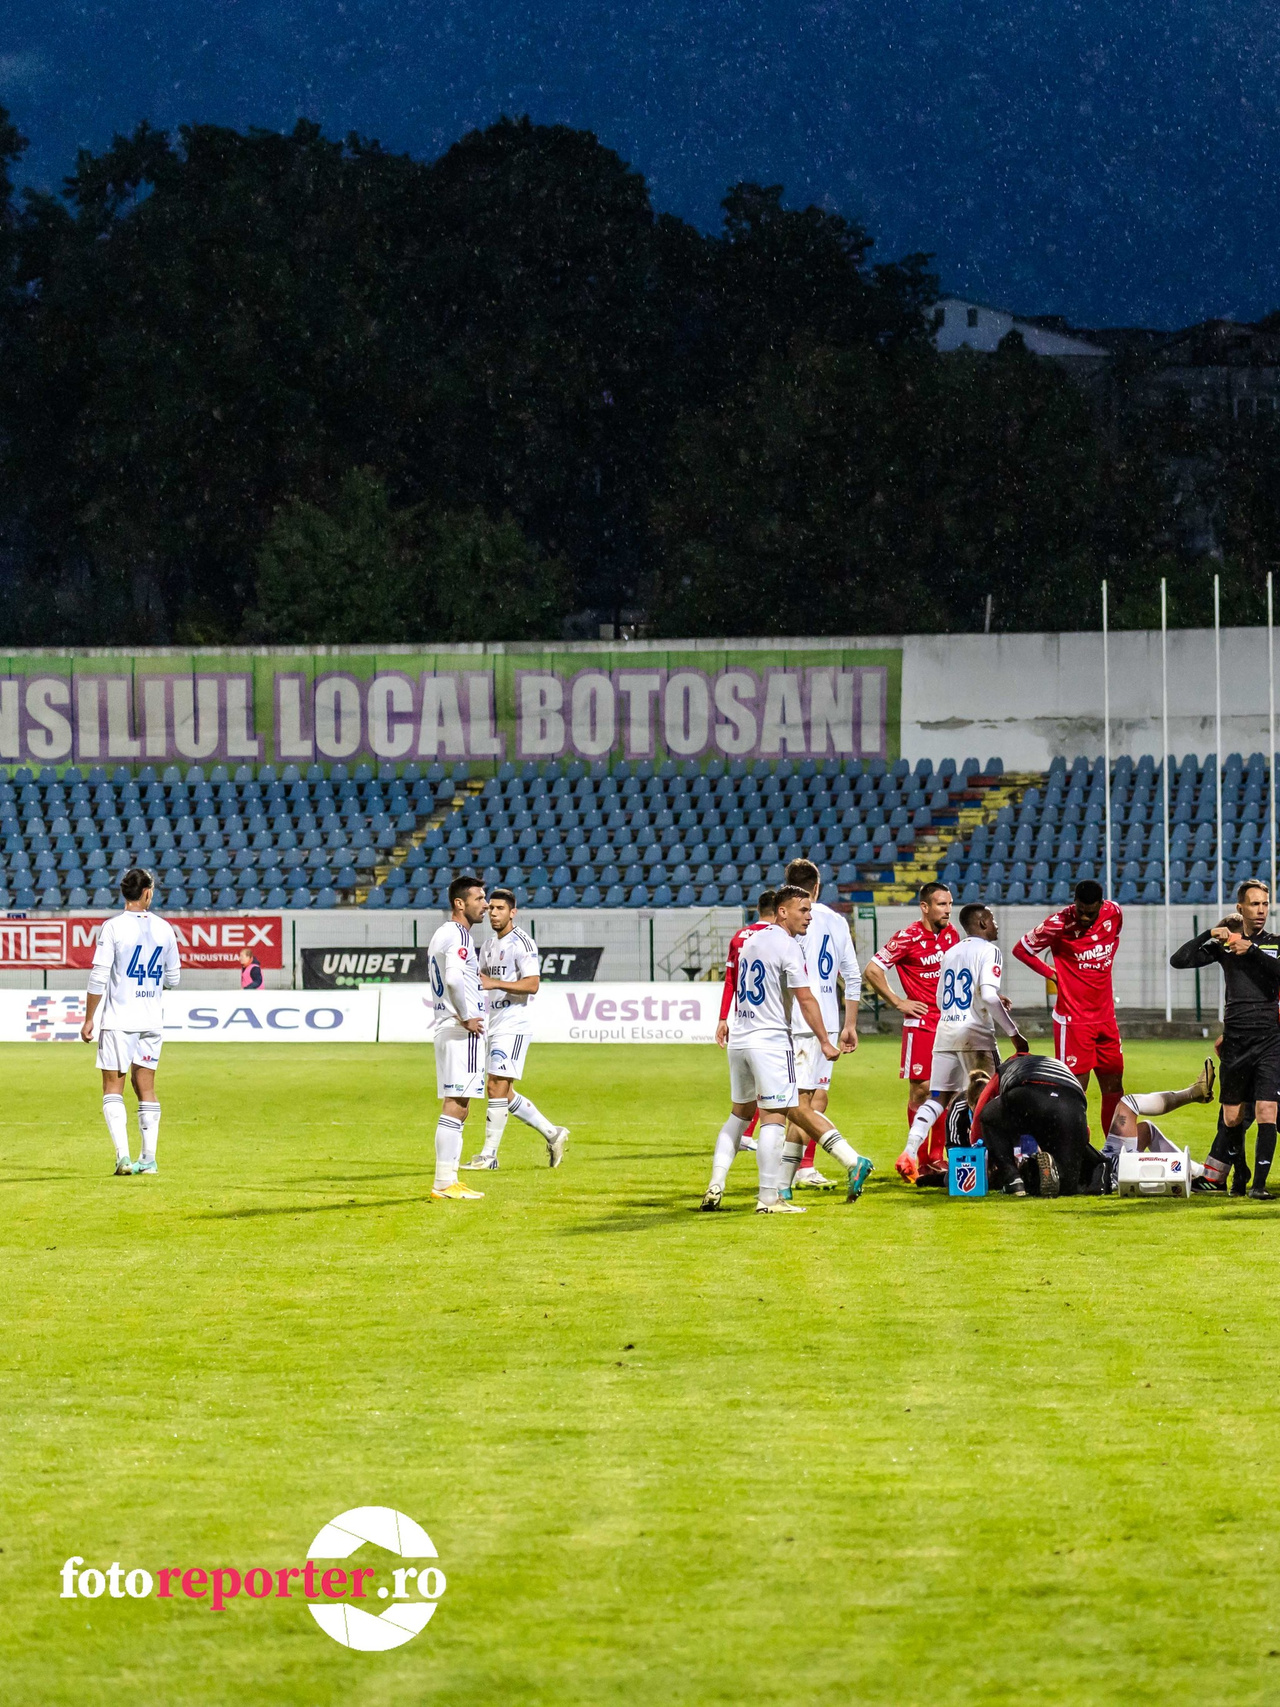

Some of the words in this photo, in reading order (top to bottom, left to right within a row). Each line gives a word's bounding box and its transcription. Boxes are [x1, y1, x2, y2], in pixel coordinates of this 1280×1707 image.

[280, 676, 500, 758] LOCAL
[521, 671, 881, 755] BOTOSANI
[126, 944, 164, 986] 44
[322, 953, 416, 975] UNIBET
[818, 934, 834, 980] 6
[737, 957, 766, 1006] 33
[942, 967, 973, 1011] 83
[162, 1007, 344, 1030] LSACO
[566, 992, 701, 1022] Vestra
[569, 1026, 626, 1042] Grupul
[631, 1026, 684, 1040] Elsaco
